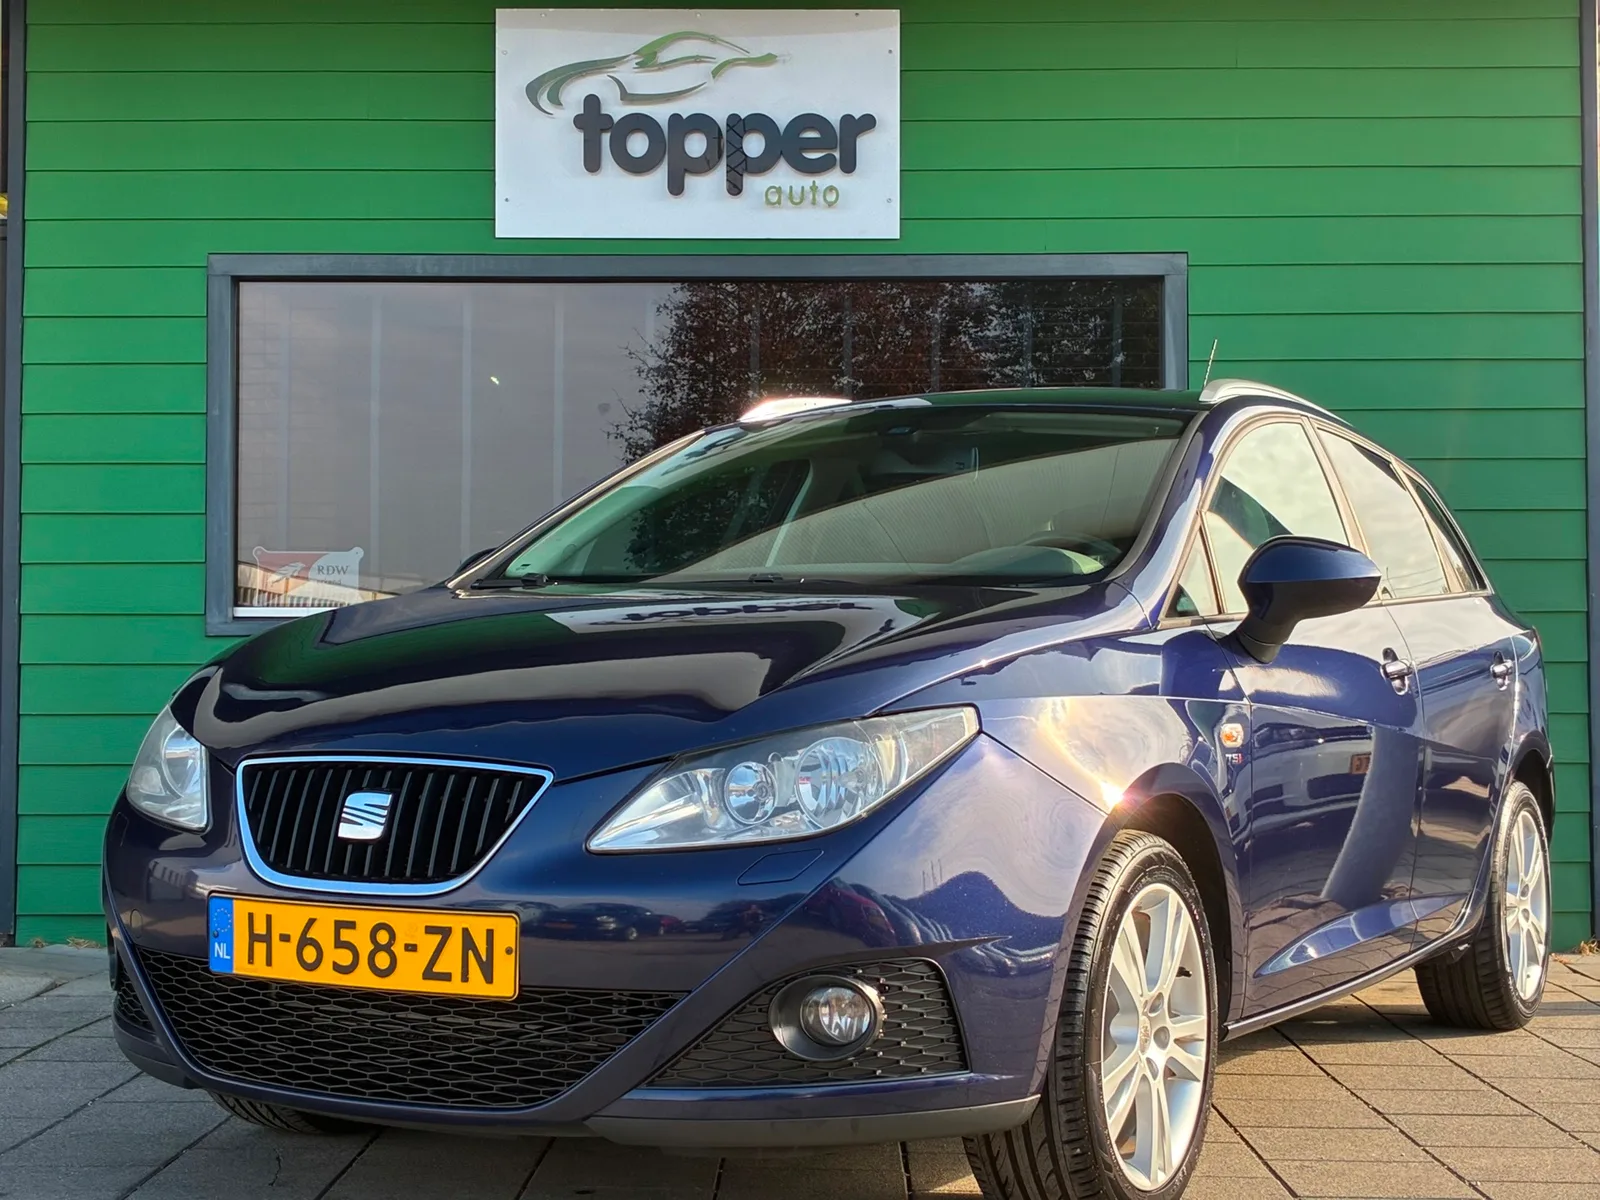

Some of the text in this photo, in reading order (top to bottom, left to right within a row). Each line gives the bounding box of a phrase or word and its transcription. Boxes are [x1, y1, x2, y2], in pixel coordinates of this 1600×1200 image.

[573, 93, 877, 196] topper
[764, 180, 840, 207] auto
[317, 565, 349, 575] RDW
[214, 941, 231, 960] NL
[247, 911, 495, 985] H-658-ZN
